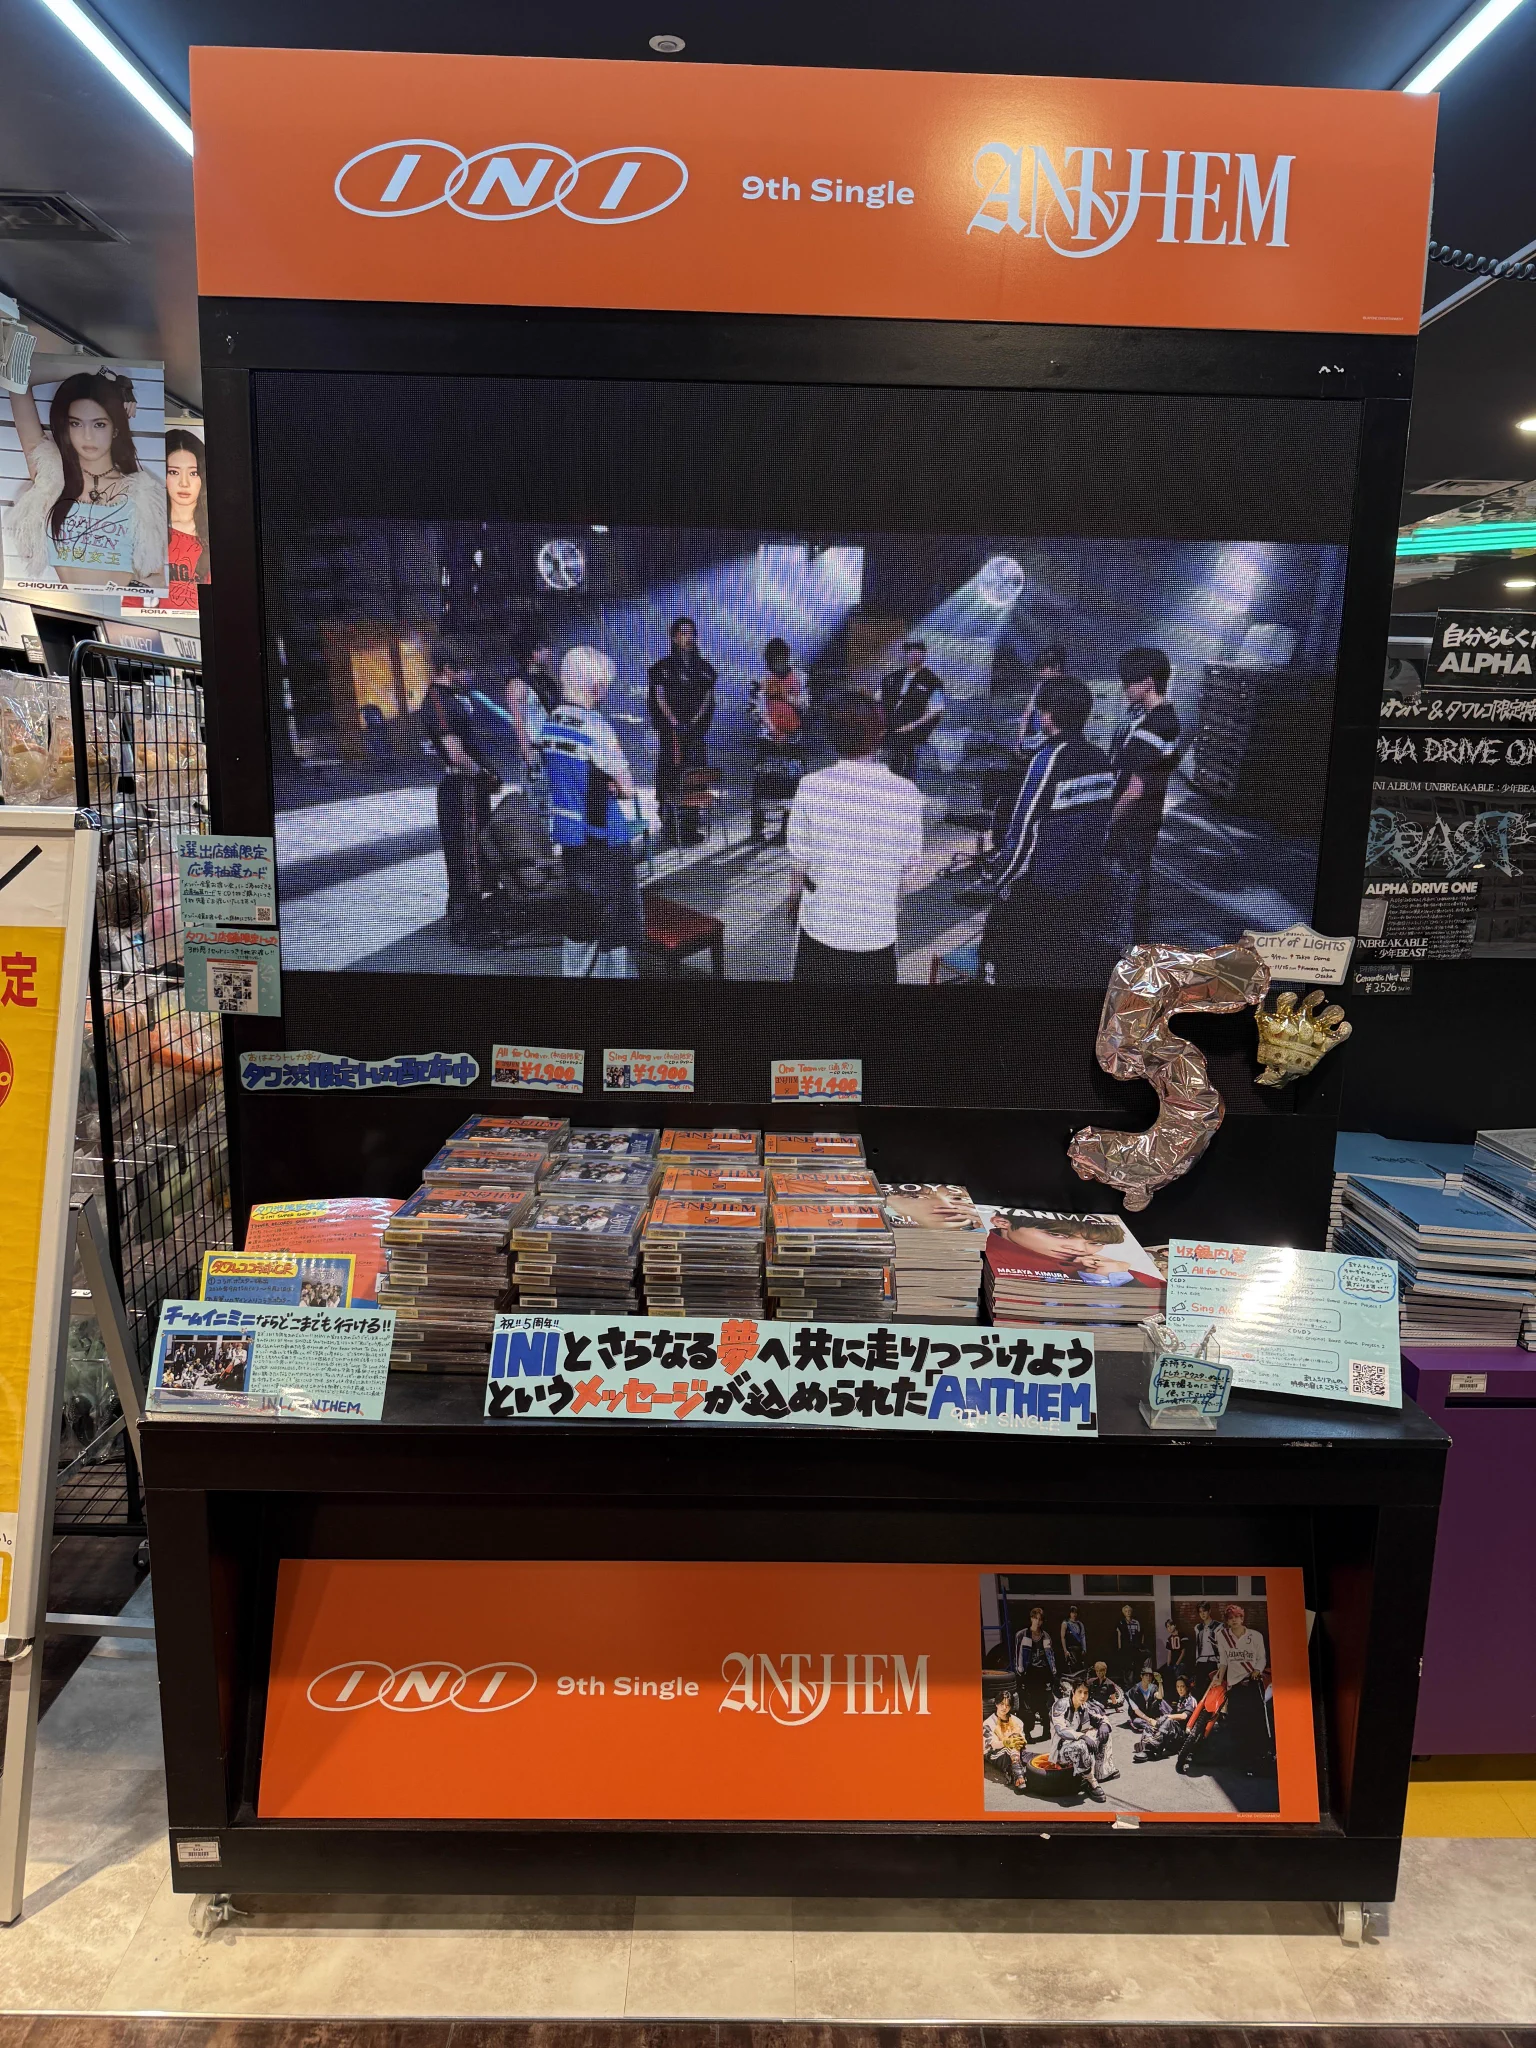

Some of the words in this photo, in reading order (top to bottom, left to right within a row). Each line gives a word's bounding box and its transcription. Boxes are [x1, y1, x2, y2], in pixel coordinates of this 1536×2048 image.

[741, 174, 803, 202] 9th
[809, 176, 916, 209] Single
[966, 141, 1297, 259] ANTHEM
[17, 581, 69, 591] CHIQUITA
[1437, 651, 1533, 675] ALPHA
[1422, 736, 1504, 766] DRIVE
[1387, 782, 1421, 791] ALBUM
[1425, 782, 1494, 792] UNBREAKABLE
[1365, 883, 1409, 895] ALPHA
[1412, 882, 1449, 894] DRIVE
[1451, 881, 1478, 893] ONE
[1256, 936, 1286, 948] CITY
[1287, 937, 1300, 948] of
[0, 951, 38, 1007] 定
[496, 1048, 509, 1058] All
[524, 1049, 540, 1059] One
[608, 1051, 628, 1062] Sing
[630, 1051, 652, 1061] Along
[1176, 1244, 1247, 1264] 収録内容
[997, 1267, 1033, 1276] MASAYA
[1034, 1270, 1069, 1278] KIMURA
[1191, 1266, 1204, 1275] All
[1205, 1267, 1218, 1275] for
[1219, 1268, 1237, 1277] One
[1191, 1302, 1215, 1314] Sing
[492, 1319, 1094, 1378] INIとさらなる夢へ共に走りつづけよう
[998, 1411, 1061, 1431] SINGLE
[556, 1676, 606, 1697] 9th
[613, 1676, 700, 1701] Single
[719, 1652, 931, 1727] ANTHEM
